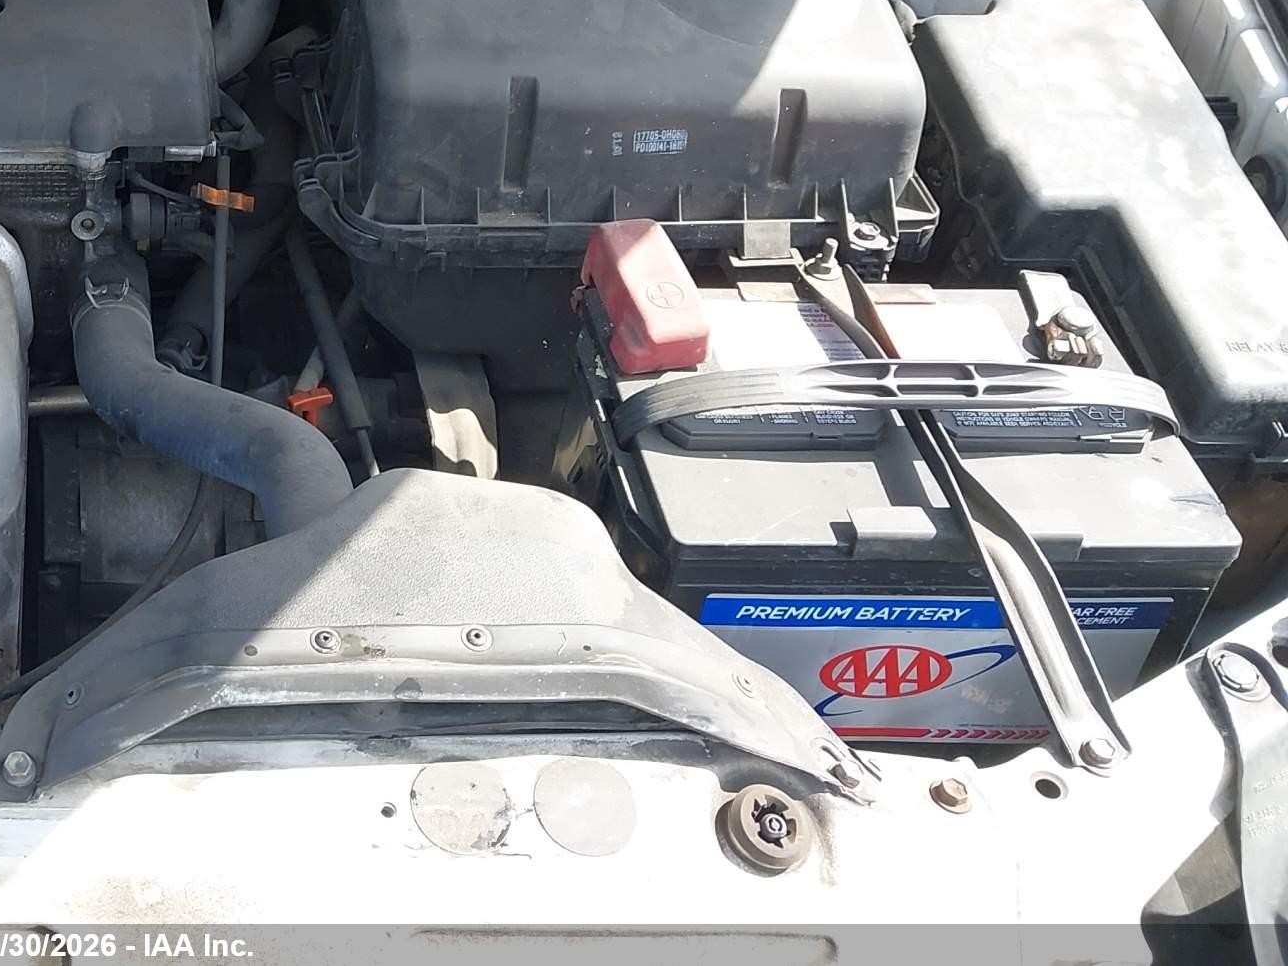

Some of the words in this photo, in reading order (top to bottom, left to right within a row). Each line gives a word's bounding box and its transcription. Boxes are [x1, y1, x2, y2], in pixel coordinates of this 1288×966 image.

[735, 605, 854, 620] PREMIUM
[855, 606, 972, 622] BATTERY
[1070, 607, 1095, 617] AR
[1095, 607, 1139, 616] FREE
[1076, 617, 1131, 625] CEMENT
[829, 646, 942, 697] AAA
